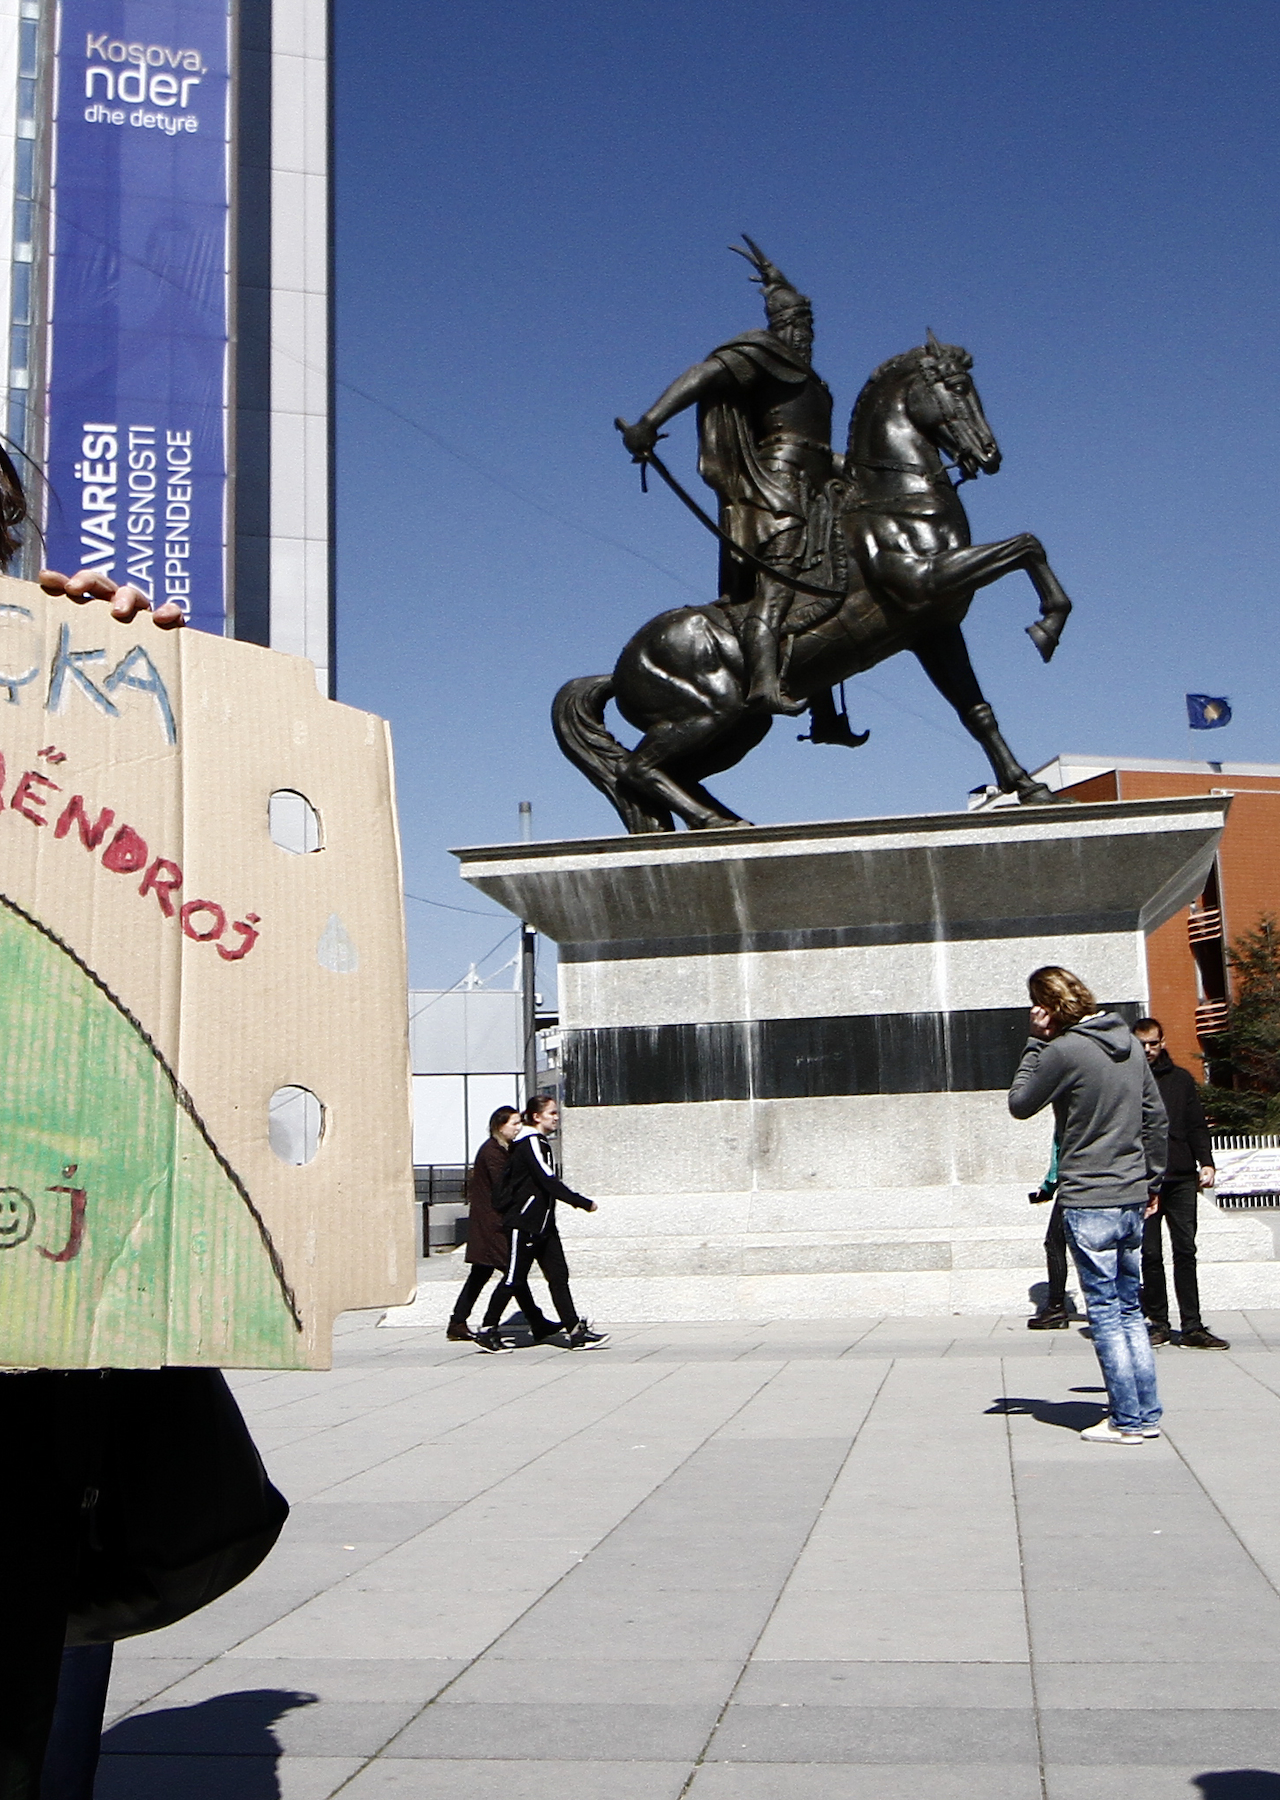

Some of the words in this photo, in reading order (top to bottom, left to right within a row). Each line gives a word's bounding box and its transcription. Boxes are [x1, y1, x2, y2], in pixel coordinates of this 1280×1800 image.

[86, 33, 208, 74] Kosova,
[85, 60, 201, 108] nder
[84, 104, 125, 126] dhe
[130, 108, 198, 136] detyrë
[126, 426, 156, 612] ZAVISNOSTI
[165, 430, 191, 623] DEPENDENCE
